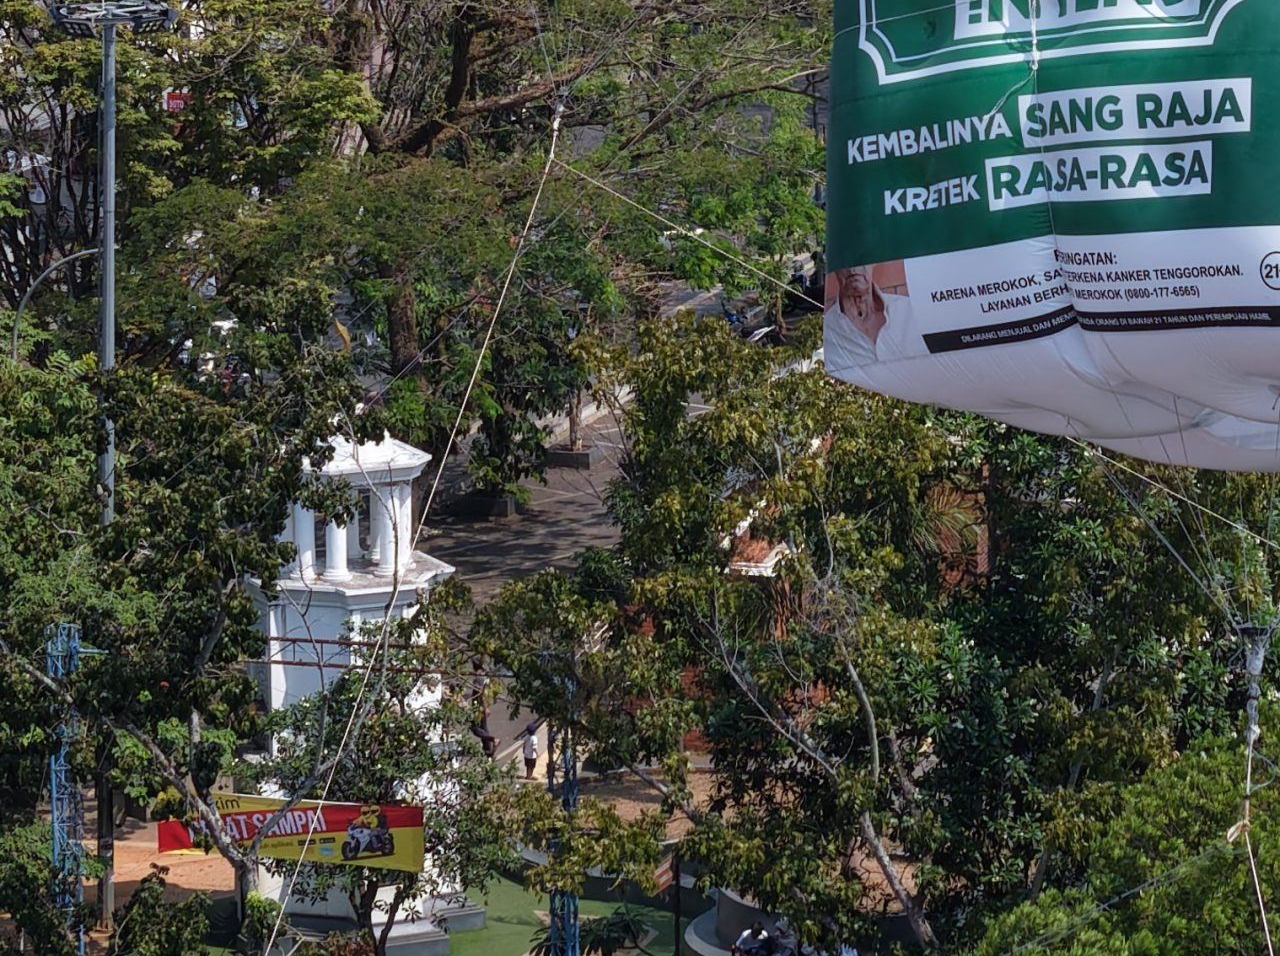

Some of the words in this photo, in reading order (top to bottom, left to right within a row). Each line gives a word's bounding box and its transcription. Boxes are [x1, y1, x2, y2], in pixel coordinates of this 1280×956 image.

[847, 112, 1014, 165] KEMBALINYA
[1025, 95, 1123, 139] SANG
[1136, 87, 1246, 129] RAJA
[884, 173, 982, 216] KRETEK
[991, 149, 1210, 201] RASA-RASA
[930, 287, 977, 303] KARENA
[978, 274, 1042, 296] MEROKOK,
[1106, 268, 1151, 283] KANKER
[1152, 265, 1244, 281] TENGGOROKAN.
[980, 296, 1032, 314] LAYANAN
[1075, 288, 1124, 301] MEROKOK
[1124, 285, 1200, 302] (0800-177-6565)
